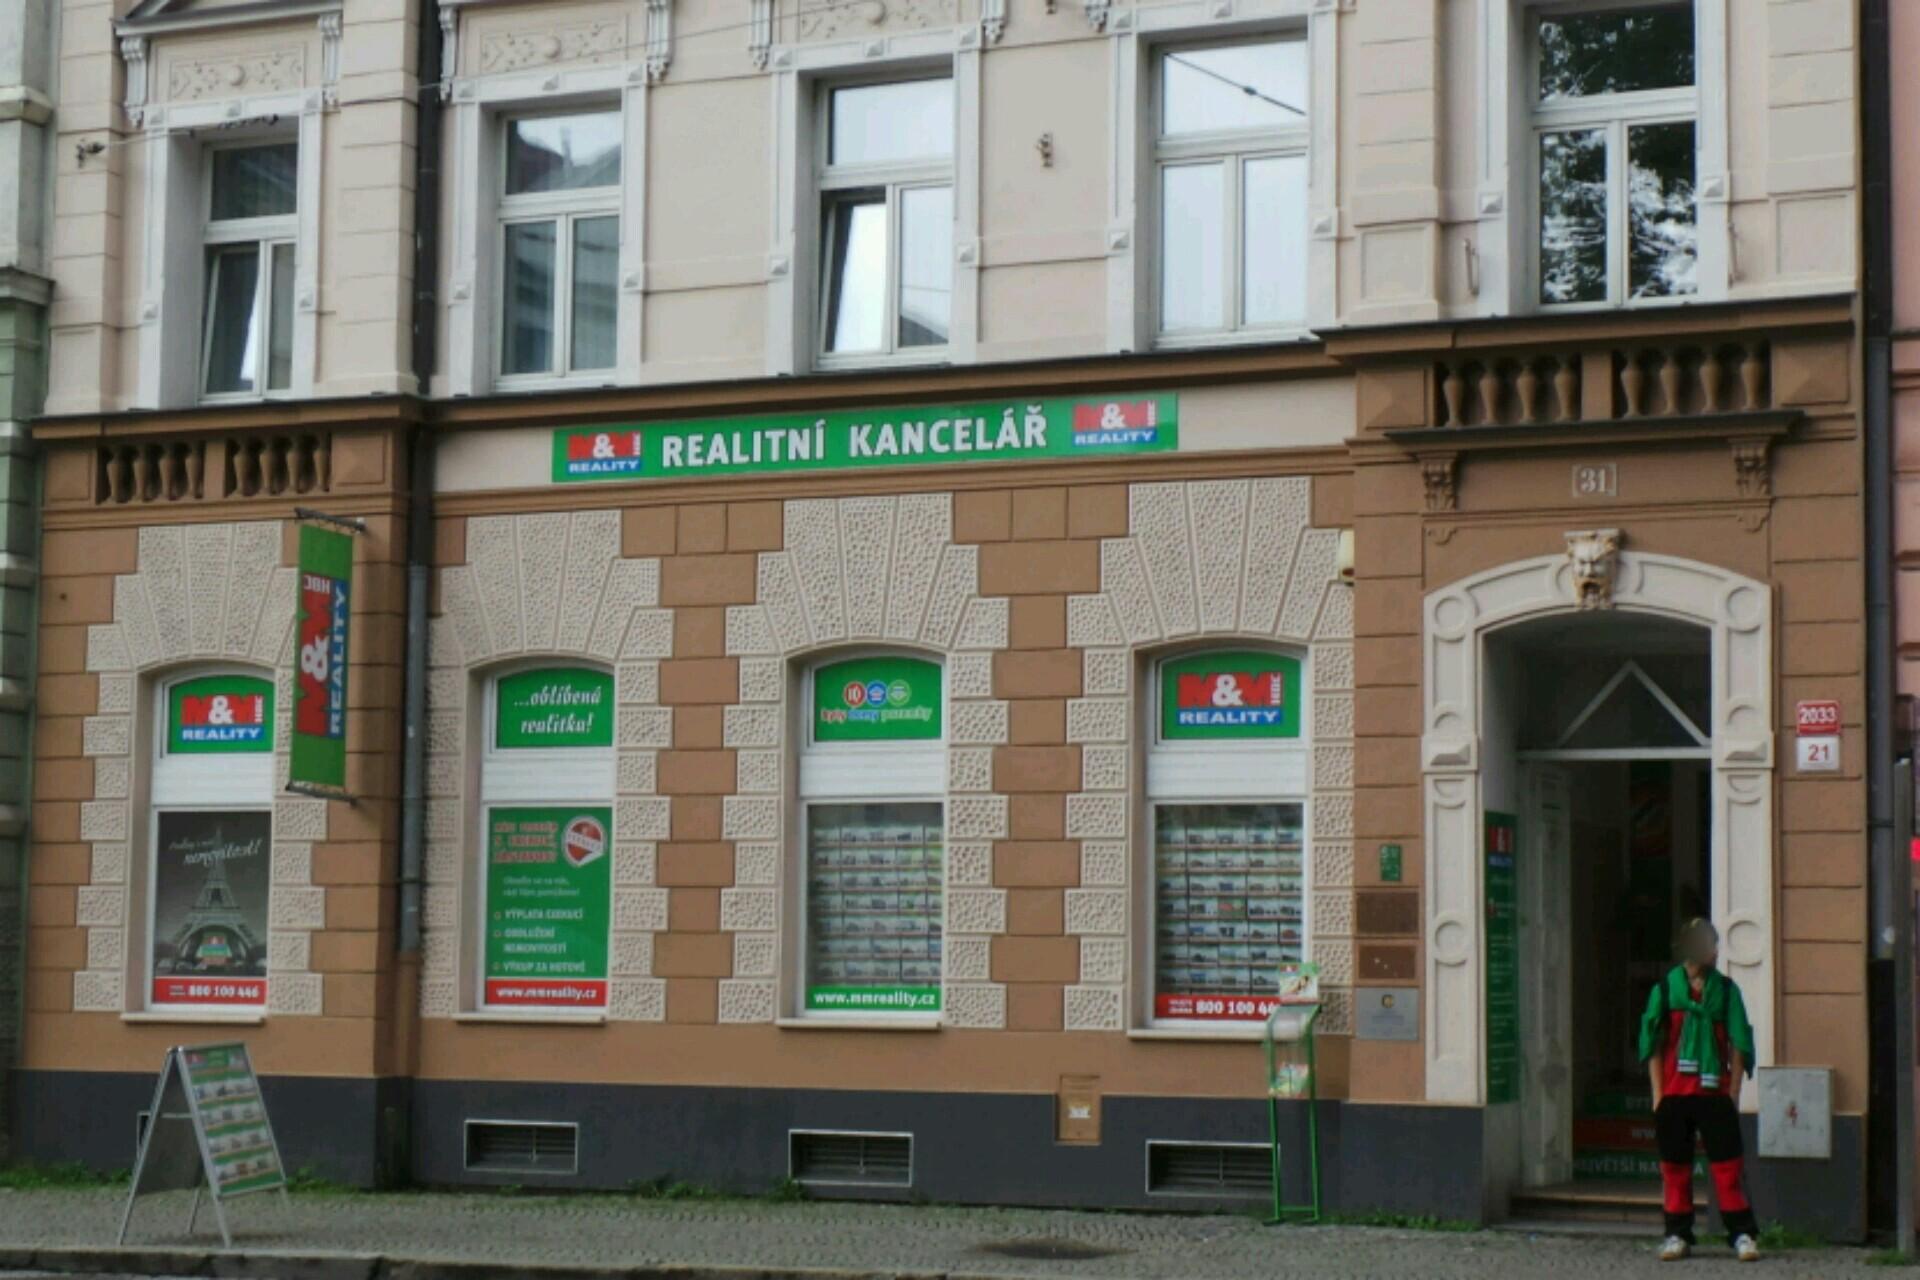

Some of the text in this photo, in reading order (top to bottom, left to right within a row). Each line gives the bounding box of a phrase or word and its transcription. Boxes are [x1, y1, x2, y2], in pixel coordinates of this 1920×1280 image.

[1073, 403, 1148, 431] M&M
[663, 419, 826, 467] REALITNÍ
[849, 405, 1047, 458] KANCELÁŘ
[1075, 430, 1154, 446] REALITY
[568, 432, 634, 460] M&M
[569, 460, 640, 473] REALITY
[296, 593, 331, 736] M&M
[329, 581, 346, 735] REALITY
[1177, 672, 1271, 708] M&M
[181, 694, 255, 726] M&M
[1179, 711, 1278, 725] REALITY
[182, 727, 261, 741] REALITY
[1807, 743, 1830, 762] 21
[496, 986, 598, 1001] www.mmreality.cz
[813, 989, 935, 1008] www.mmreality.cz
[1196, 999, 1224, 1014] 800
[1228, 1000, 1255, 1015] 100
